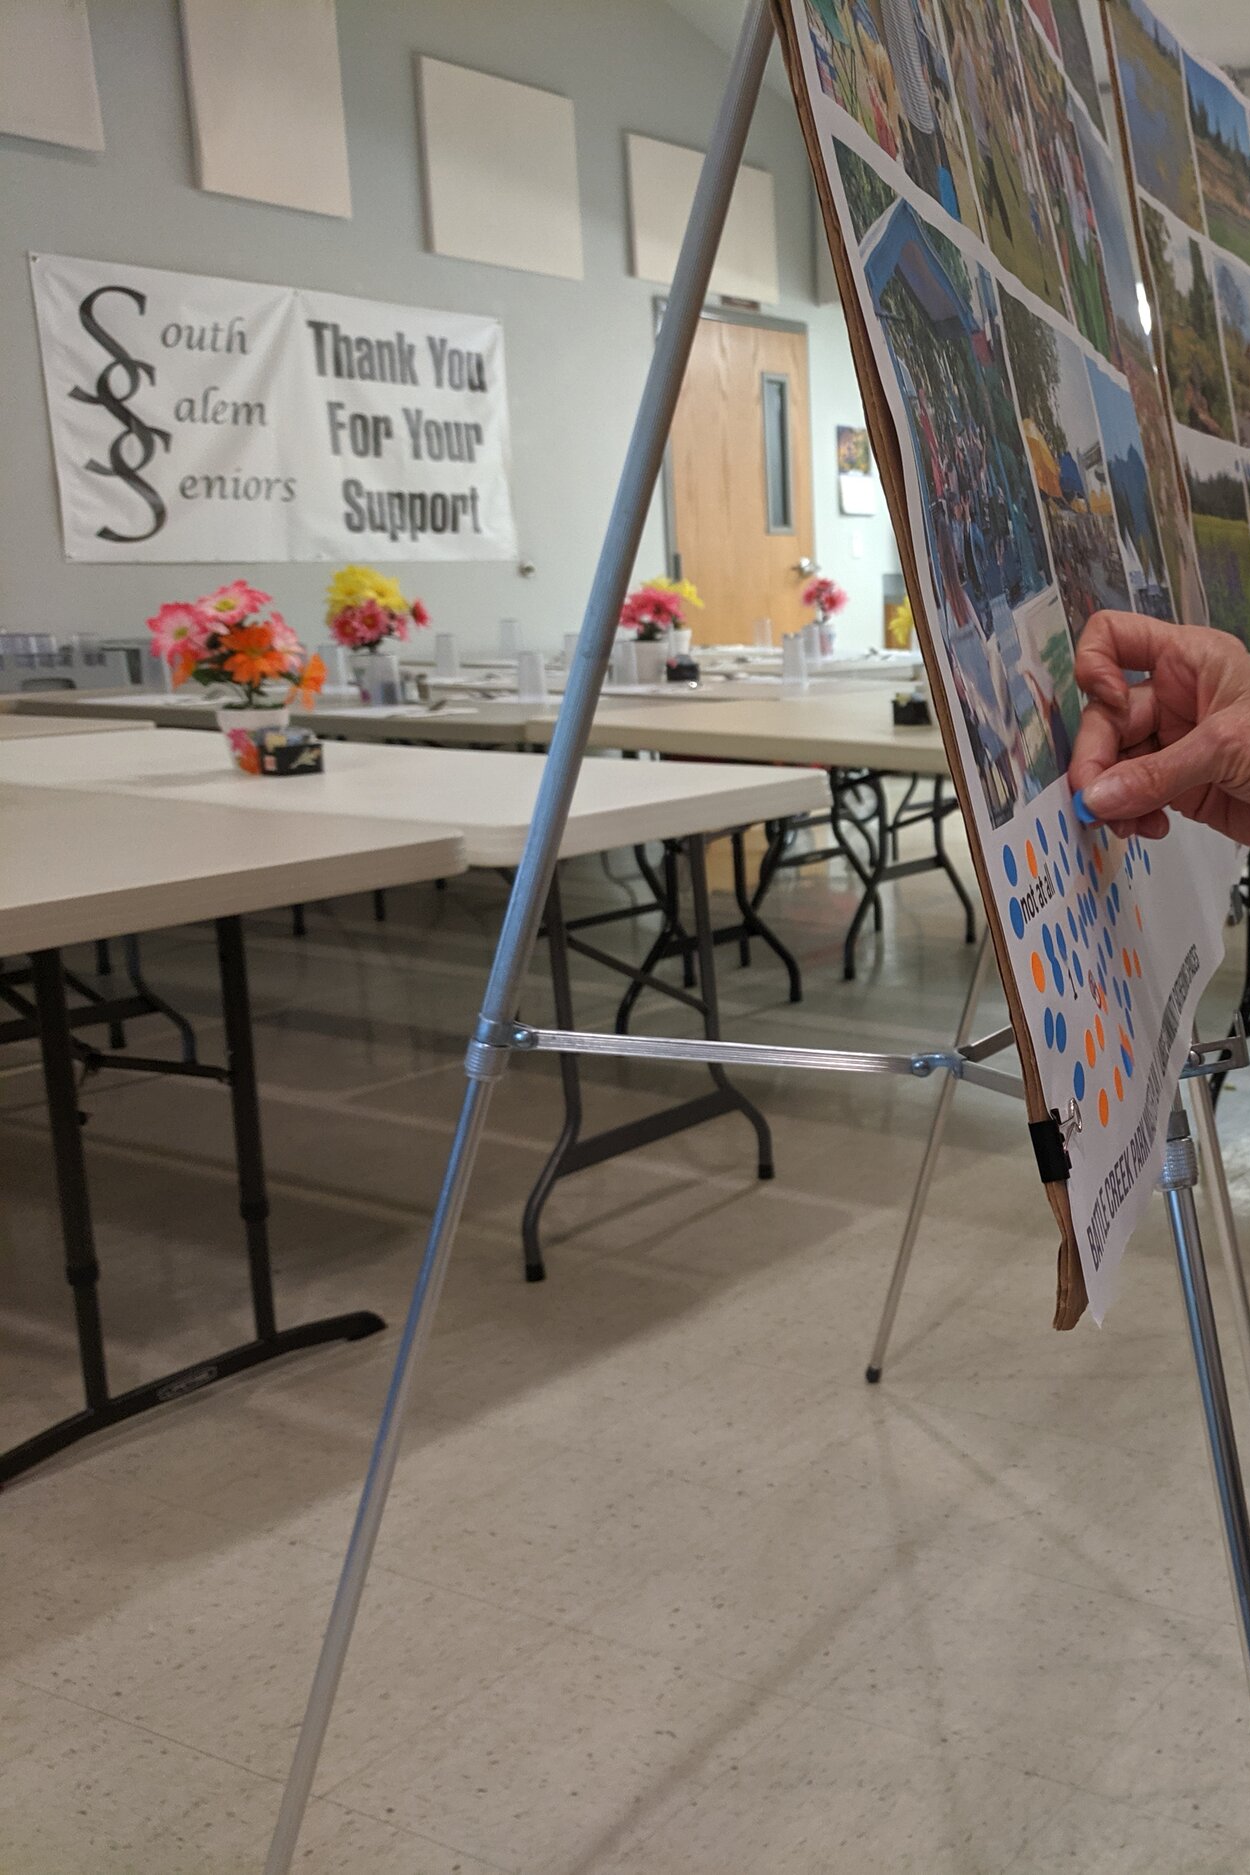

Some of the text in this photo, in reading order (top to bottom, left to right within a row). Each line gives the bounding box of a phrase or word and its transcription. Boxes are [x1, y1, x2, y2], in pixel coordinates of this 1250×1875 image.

[307, 320, 488, 393] Thank You
[327, 401, 483, 463] For Your
[342, 478, 482, 543] Support
[1020, 862, 1055, 924] not at all
[1086, 1117, 1150, 1272] BATTLE CREEK PARK
